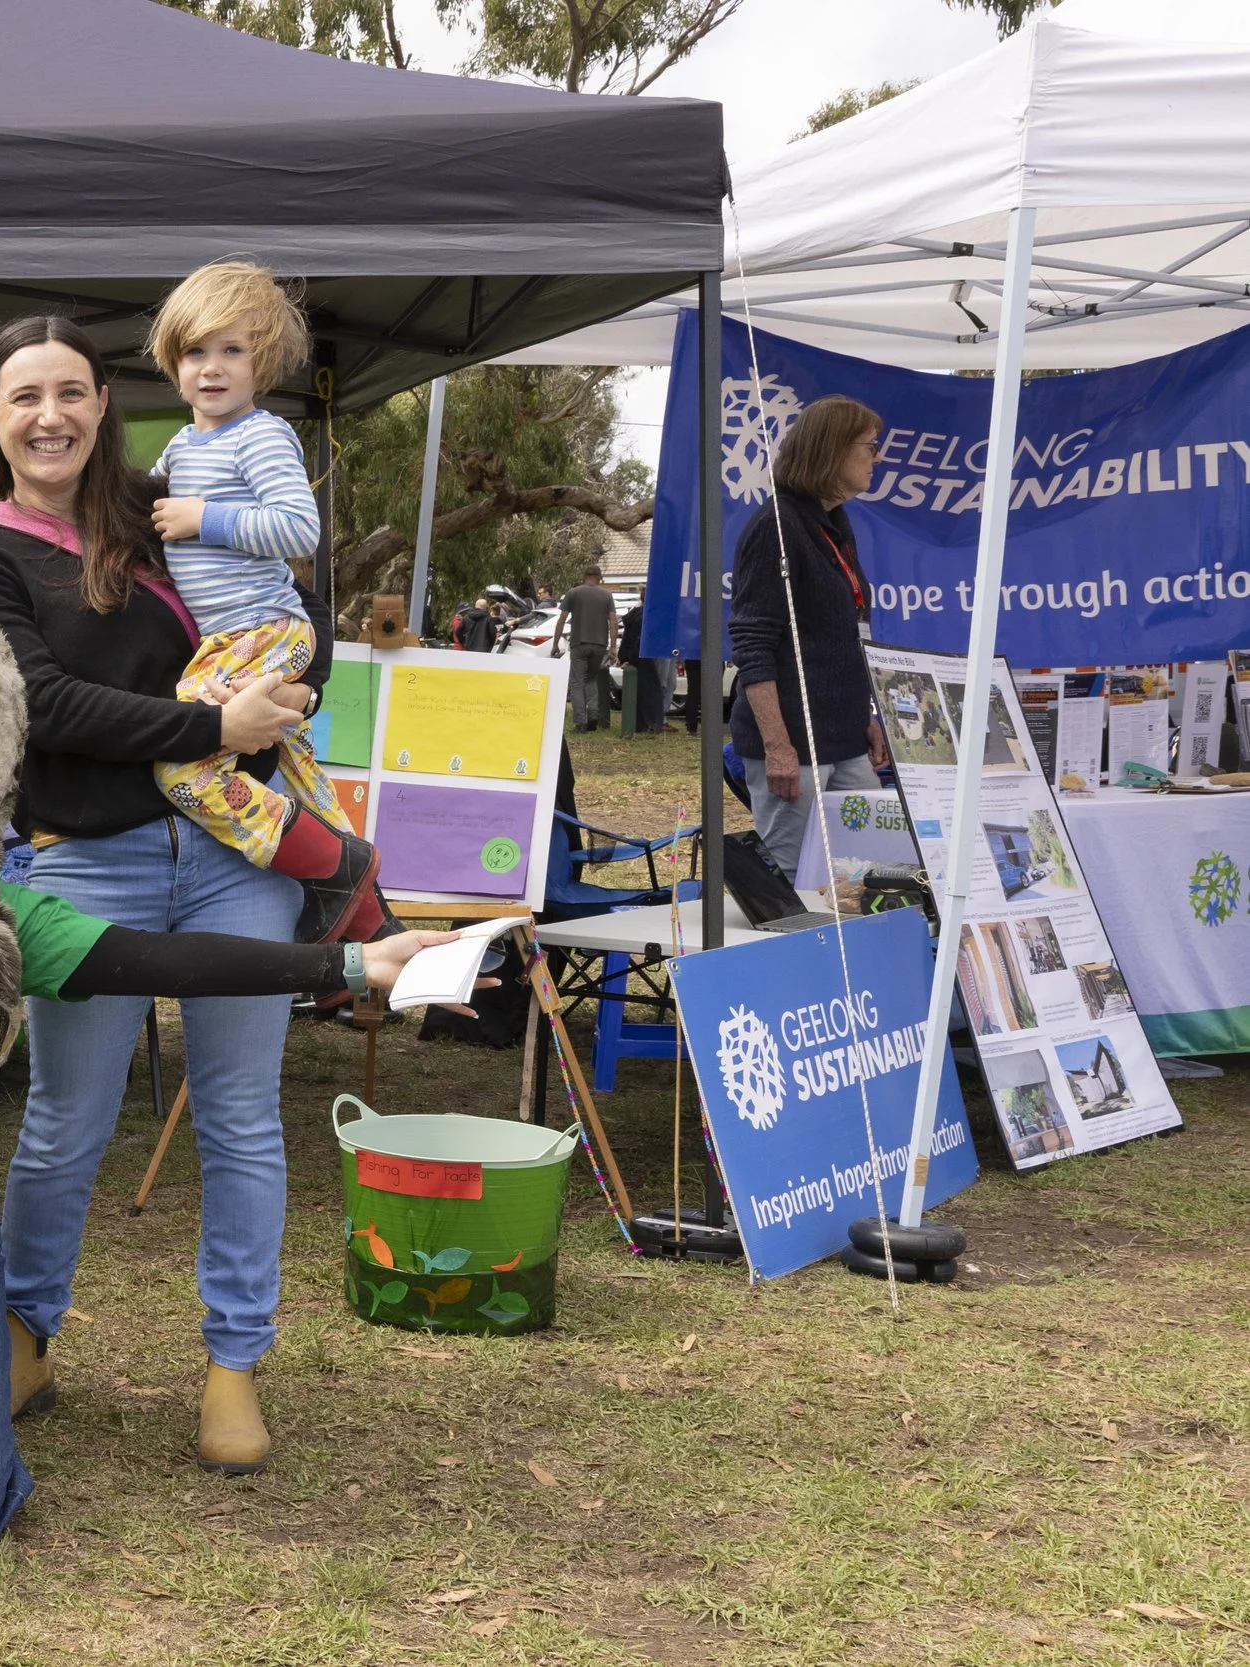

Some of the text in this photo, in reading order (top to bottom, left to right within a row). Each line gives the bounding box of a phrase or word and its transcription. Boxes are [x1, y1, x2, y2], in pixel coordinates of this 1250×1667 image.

[880, 428, 1094, 474] EELONG
[855, 441, 1250, 514] USTANABILITY
[869, 562, 1250, 620] ope trough actio
[407, 672, 417, 684] 2
[396, 788, 407, 802] 4
[875, 815, 910, 832] SUST
[780, 989, 878, 1052] GEELONG
[792, 1020, 929, 1102] SUSTAINABILIT
[356, 1153, 481, 1187] Fishing For Facts
[751, 1118, 965, 1230] Inspiring hope thro action
